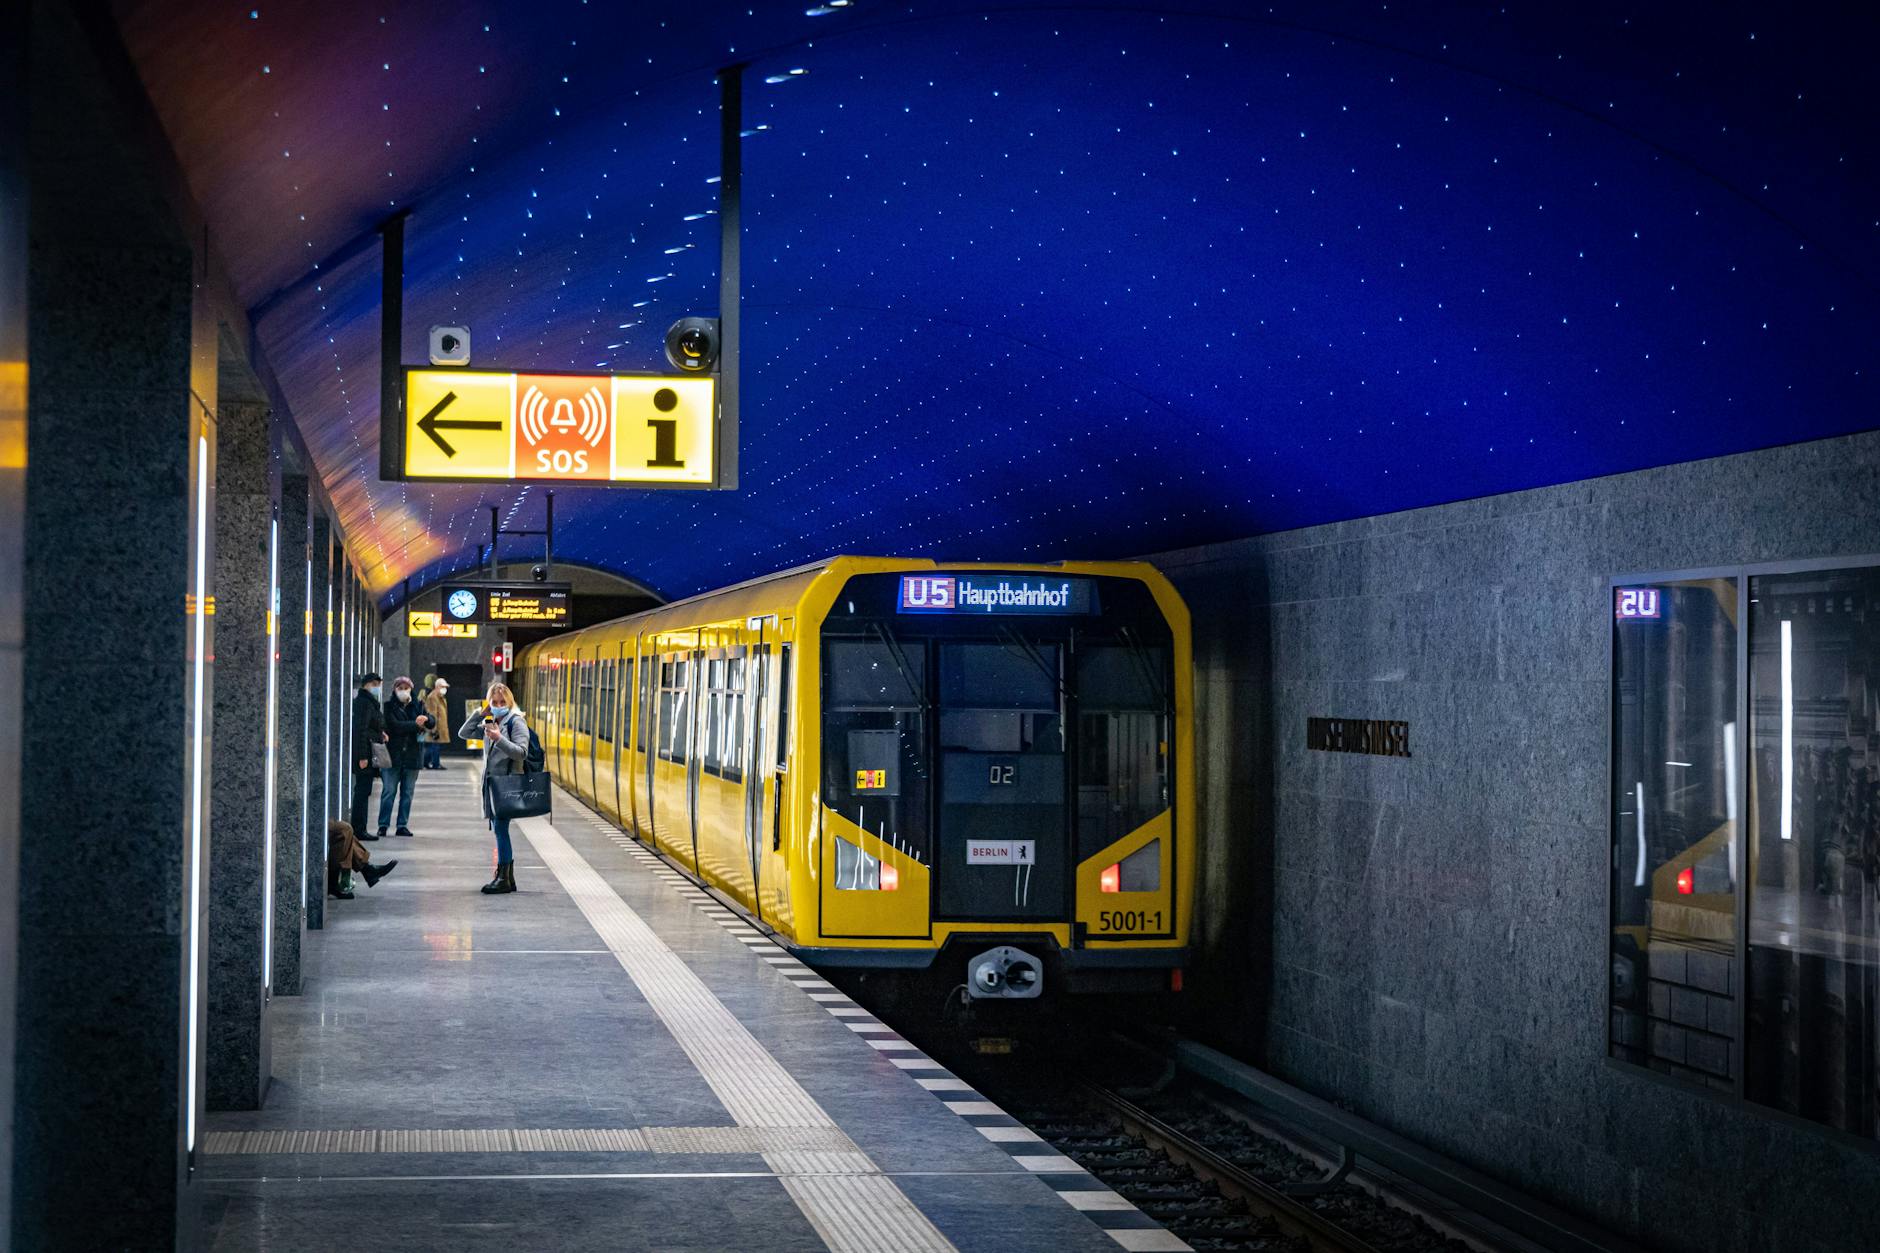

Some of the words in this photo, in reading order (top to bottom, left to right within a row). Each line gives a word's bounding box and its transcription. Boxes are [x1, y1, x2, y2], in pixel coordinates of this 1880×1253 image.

[536, 449, 588, 473] SOS
[908, 579, 949, 606] U5
[959, 581, 1069, 612] Hauptbahnhof
[990, 766, 1014, 784] 02
[972, 847, 1008, 857] BERLIN
[1099, 910, 1162, 931] 5001-1
